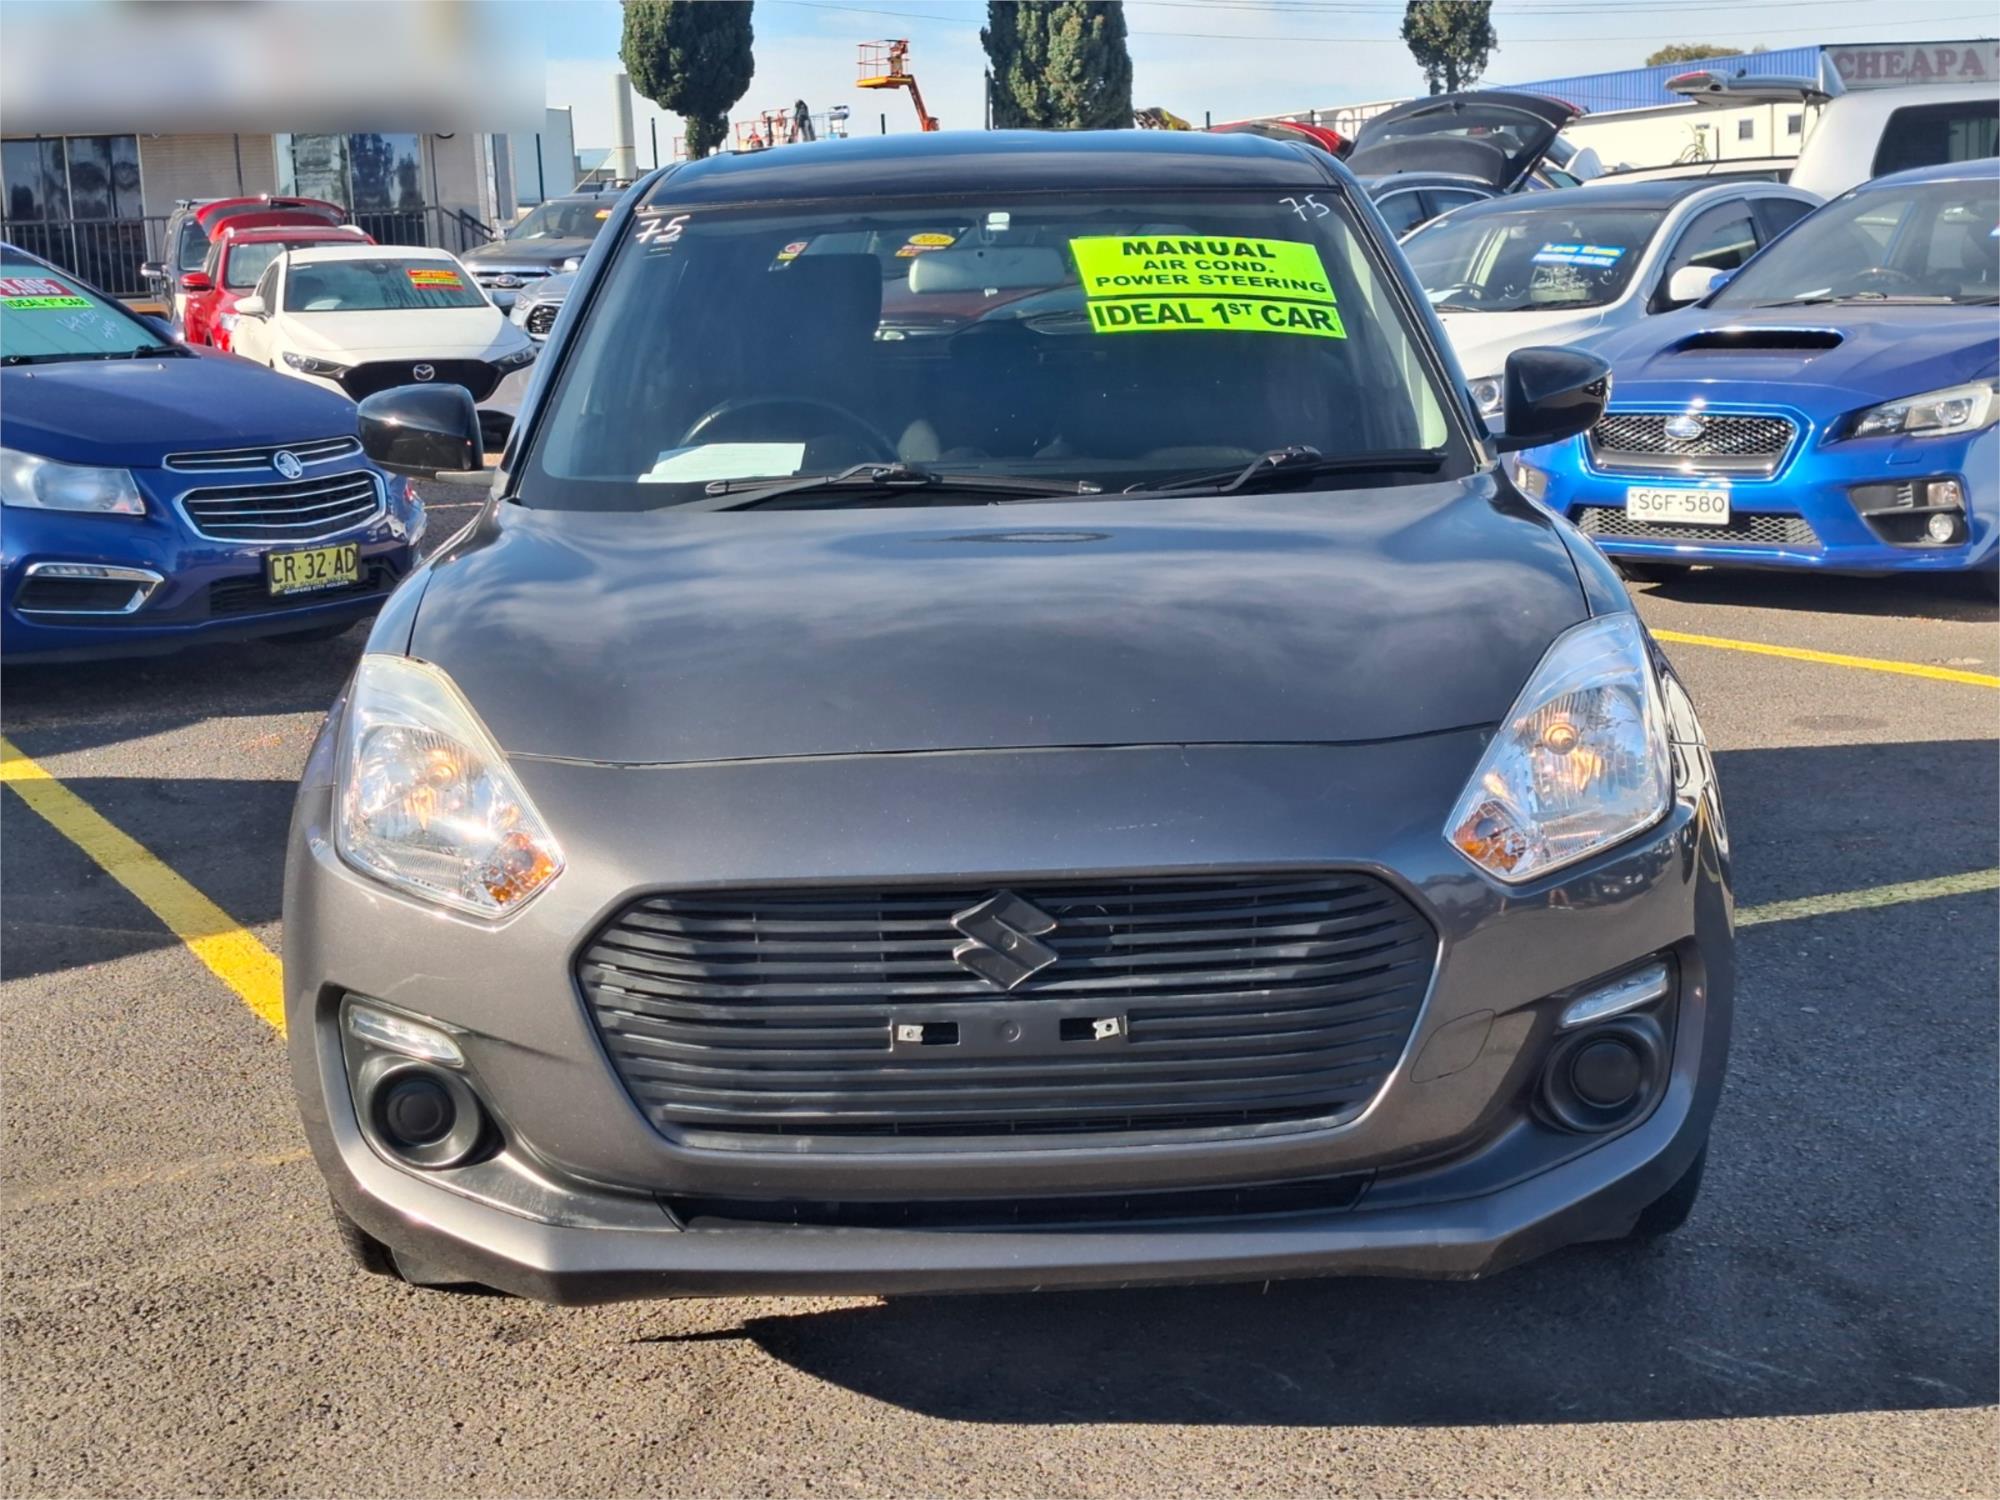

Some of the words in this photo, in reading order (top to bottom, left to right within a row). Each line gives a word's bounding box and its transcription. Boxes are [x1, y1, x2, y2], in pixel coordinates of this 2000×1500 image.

[1279, 194, 1330, 221] 75
[636, 214, 690, 243] 75
[1122, 241, 1276, 258] MANUAL
[1143, 260, 1186, 270] AIR
[1194, 260, 1275, 273] COND.
[1095, 274, 1190, 287] POWER
[1198, 275, 1327, 293] STEERING
[1094, 303, 1205, 327] IDEAL
[1260, 305, 1337, 331] CAR
